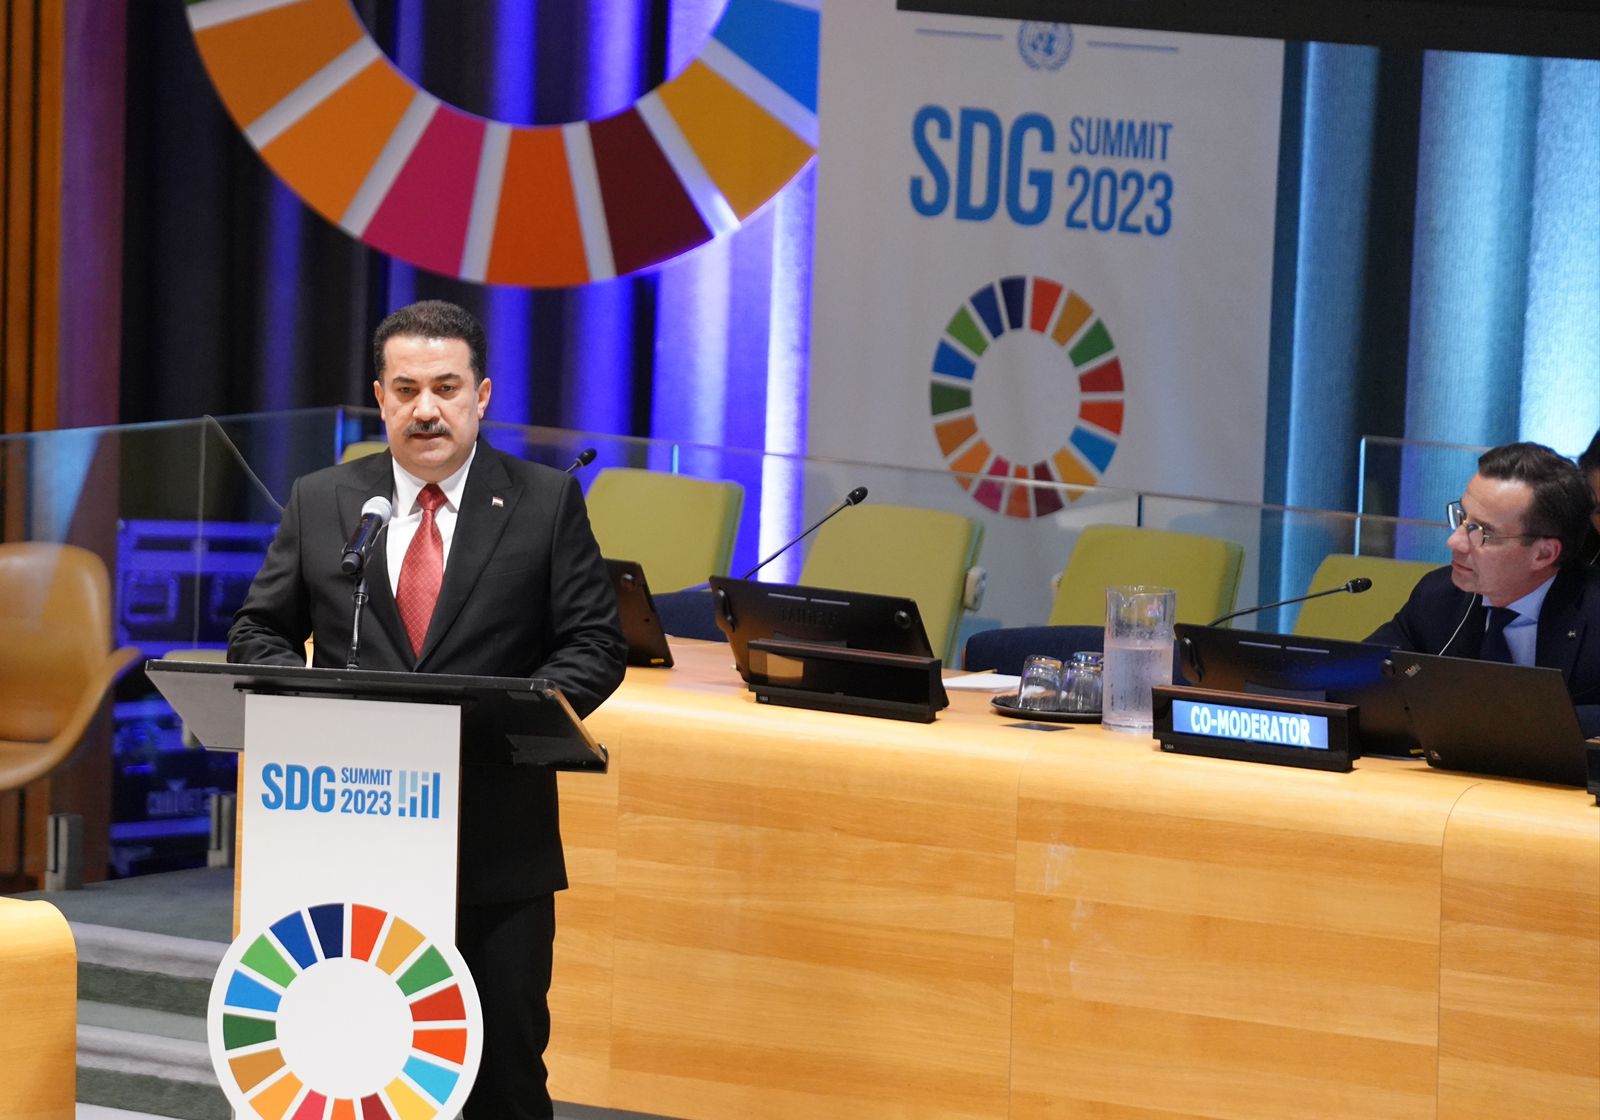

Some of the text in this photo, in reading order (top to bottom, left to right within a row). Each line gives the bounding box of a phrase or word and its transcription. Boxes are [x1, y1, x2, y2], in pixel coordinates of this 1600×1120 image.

[1069, 116, 1173, 161] SUMMIT
[910, 105, 1055, 227] SDG
[1066, 166, 1173, 236] 2023
[1190, 705, 1311, 745] CO-MODERATOR
[261, 763, 336, 813] SDG
[341, 767, 392, 786] SUMMIT
[341, 788, 392, 816] 2023
